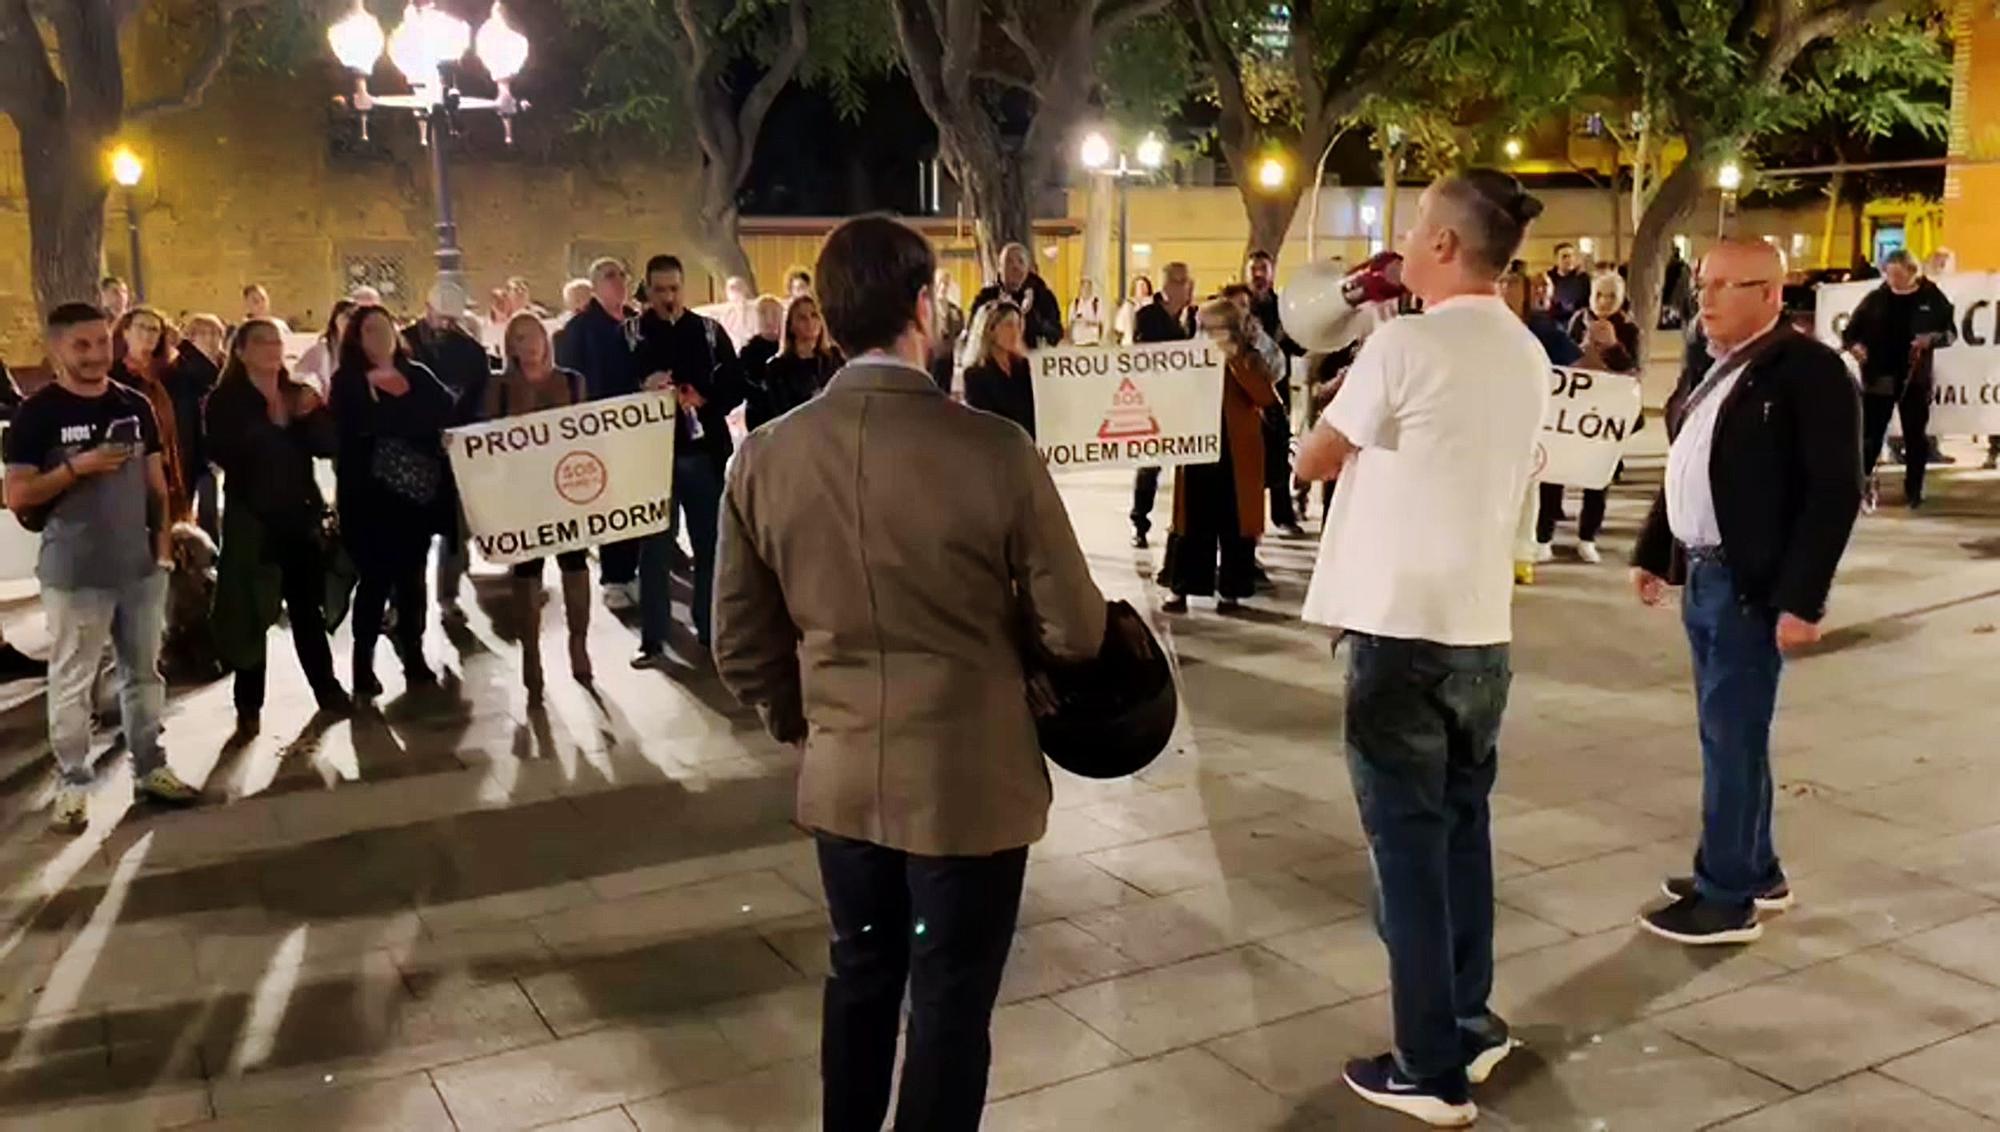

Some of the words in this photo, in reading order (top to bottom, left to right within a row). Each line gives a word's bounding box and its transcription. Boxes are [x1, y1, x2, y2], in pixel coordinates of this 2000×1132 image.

[1042, 354, 1109, 377] PROU
[1117, 349, 1217, 374] SOROLL
[464, 423, 549, 459] PROU
[559, 400, 674, 440] SOROLL
[1543, 406, 1625, 442] LÓN
[1040, 442, 1119, 465] VOLEM
[1127, 434, 1218, 458] DORMIR
[476, 519, 579, 555] VOLEM
